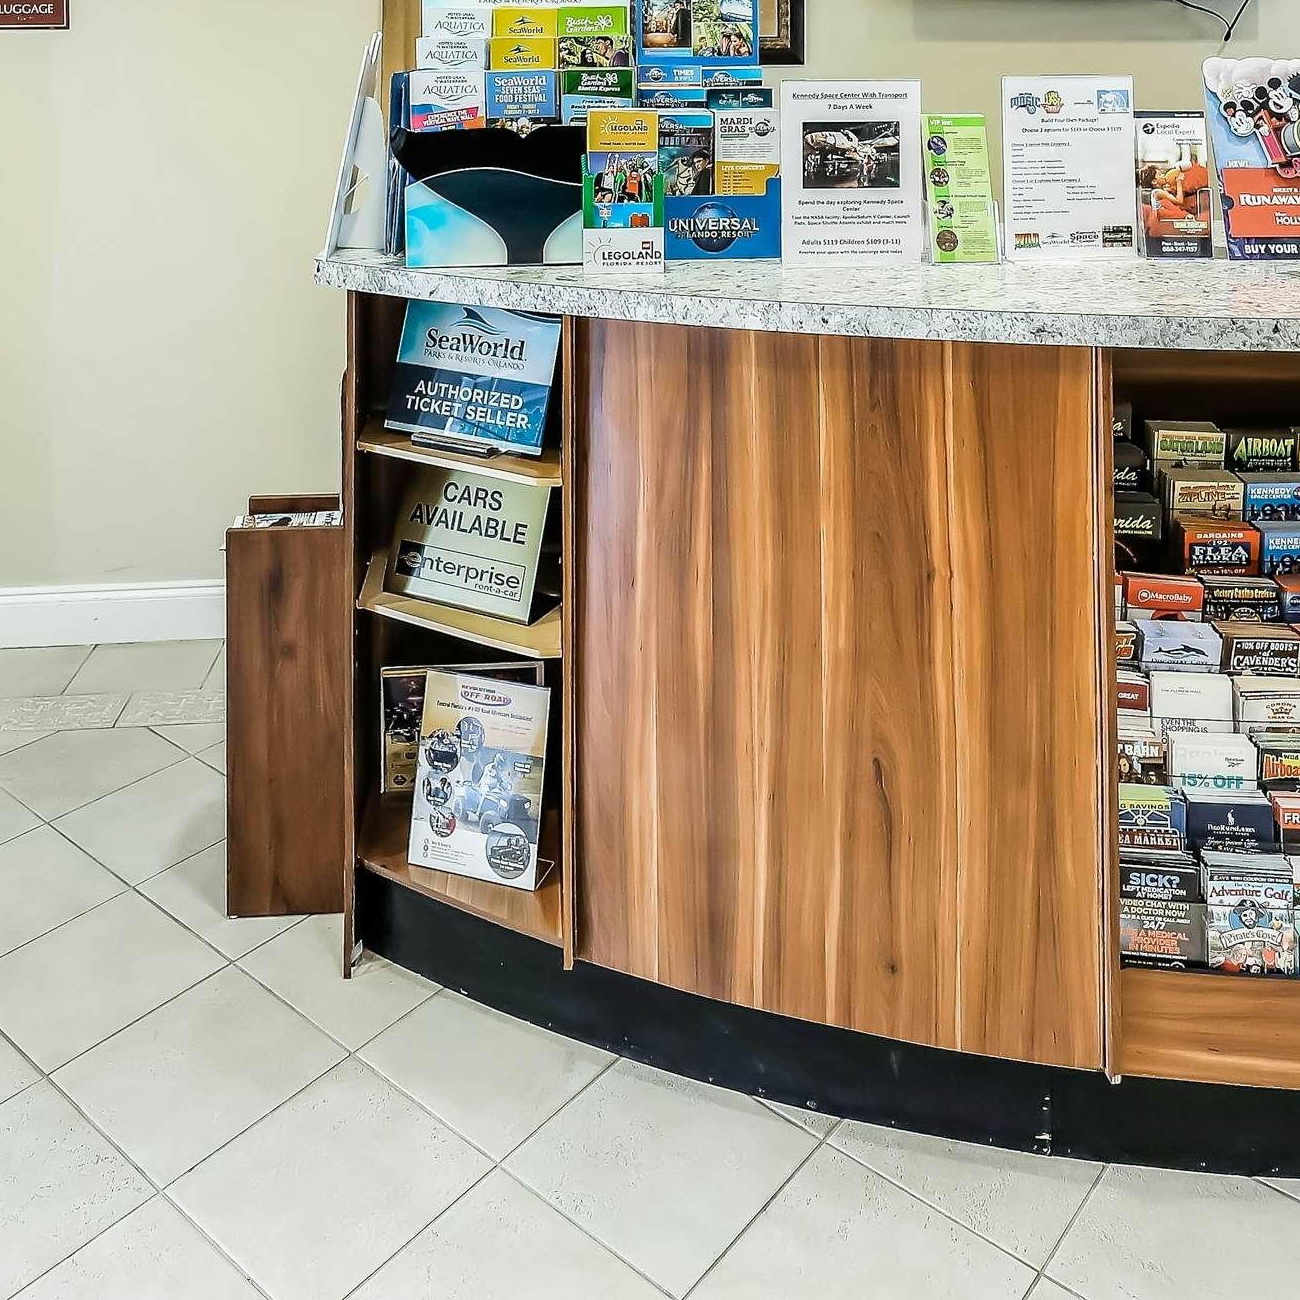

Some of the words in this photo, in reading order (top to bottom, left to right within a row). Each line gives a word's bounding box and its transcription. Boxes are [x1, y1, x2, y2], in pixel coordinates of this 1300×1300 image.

[435, 21, 485, 31] AQUATICA
[425, 50, 478, 60] AQUATICA
[495, 76, 547, 86] SeaWorld
[423, 85, 478, 94] AQUATICA
[501, 86, 522, 94] SEVEN
[523, 86, 541, 94] SEAS
[495, 94, 513, 102] FOOD
[515, 94, 547, 102] FESTIVAL
[668, 218, 759, 231] UNIVERSAL
[602, 246, 662, 260] LEGOLAND
[1244, 244, 1267, 253] BUY
[1268, 244, 1298, 253] YOUR
[414, 379, 523, 410] AUTHORIZED
[405, 394, 462, 417] TICKET
[465, 405, 530, 429] SELLER
[1234, 436, 1294, 460] AIRBOAT
[443, 481, 504, 512] CARS
[409, 503, 528, 545] AVAILABLE
[400, 551, 520, 590] enterprise
[1151, 592, 1193, 603] MacroBaby
[1242, 643, 1255, 651] 10%
[1256, 642, 1269, 650] OFF
[1270, 643, 1293, 651] BOOTS
[485, 695, 508, 703] ROAD
[1180, 773, 1209, 788] 15%
[1213, 775, 1244, 789] OFF
[1129, 872, 1180, 888] SICK?
[1142, 887, 1187, 896] MEDICATION
[1210, 888, 1261, 898] Adventure
[1264, 888, 1290, 900] Golf
[1146, 901, 1167, 909] CHAT
[1168, 903, 1190, 911] WITH
[1130, 907, 1163, 916] DOCTOR
[1165, 909, 1186, 917] NOW
